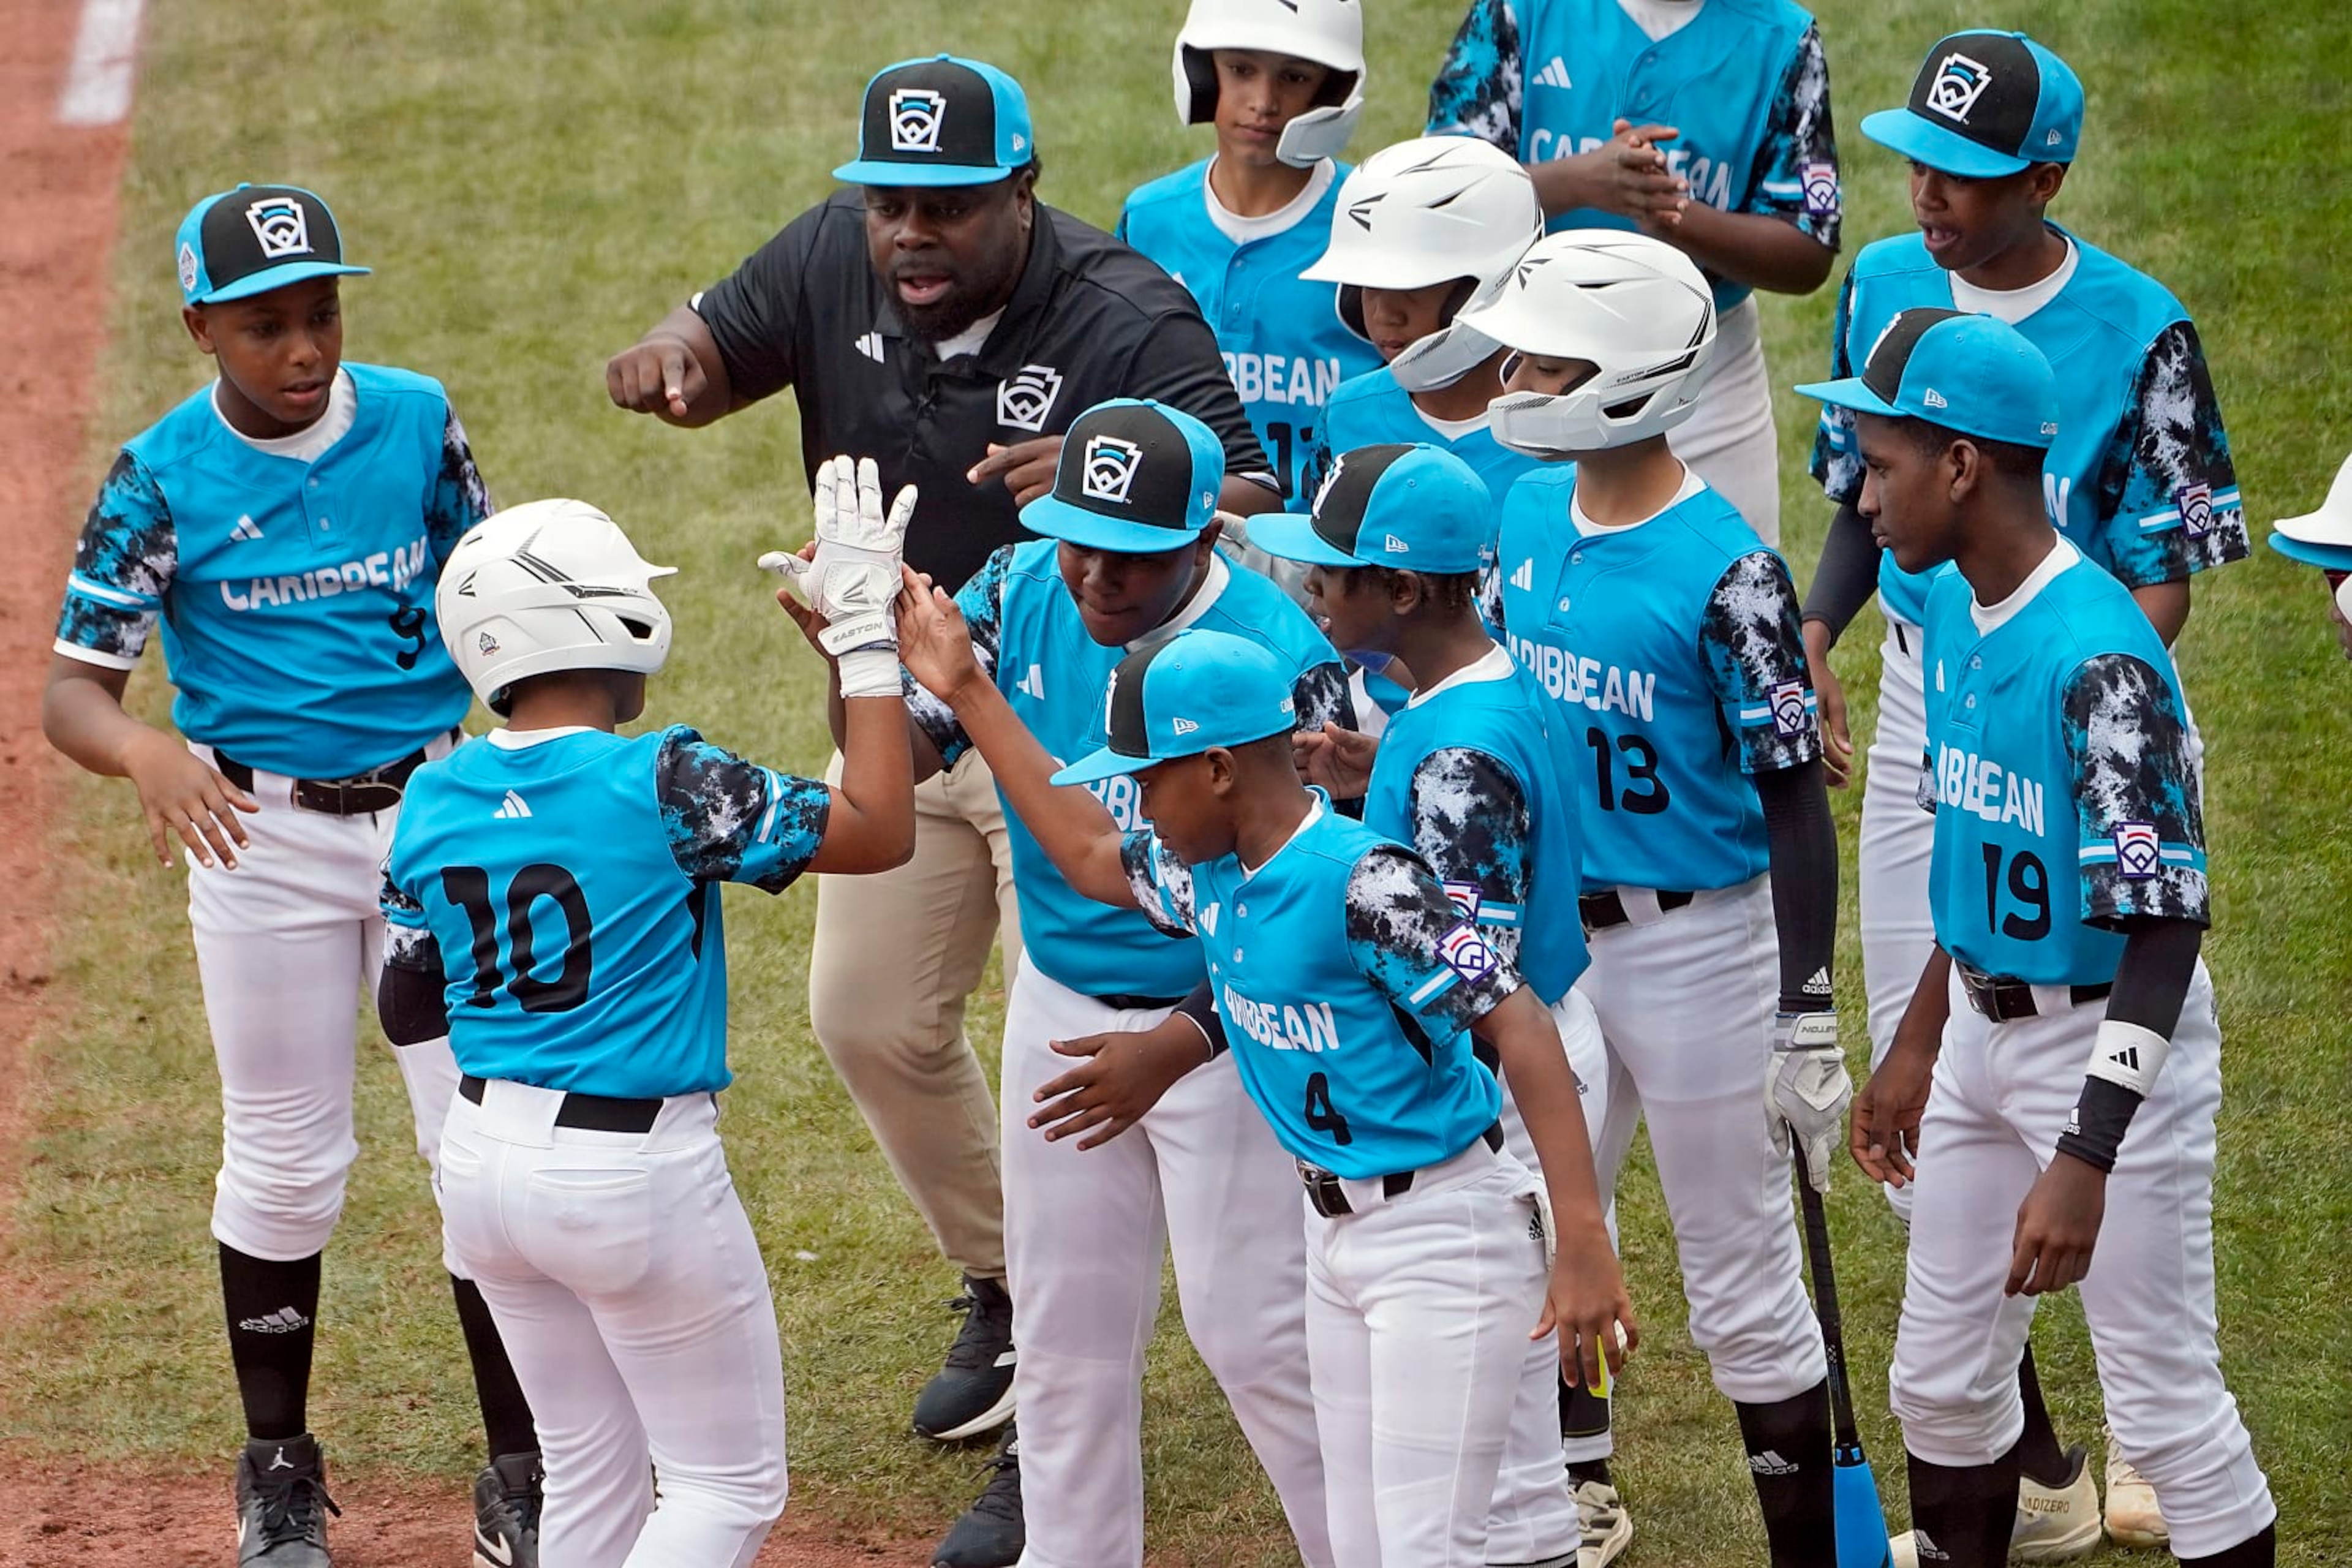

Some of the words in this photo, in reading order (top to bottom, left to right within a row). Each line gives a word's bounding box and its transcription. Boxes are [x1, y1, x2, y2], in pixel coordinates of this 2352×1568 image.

[1267, 422, 1313, 499] 1
[388, 603, 426, 670] 9
[833, 621, 883, 643] EASTON
[1506, 630, 1656, 722] RIBBEAN
[1586, 726, 1671, 814] 13
[1981, 841, 2051, 941] 19
[439, 864, 593, 1013] 10
[1305, 1072, 1352, 1145] 4
